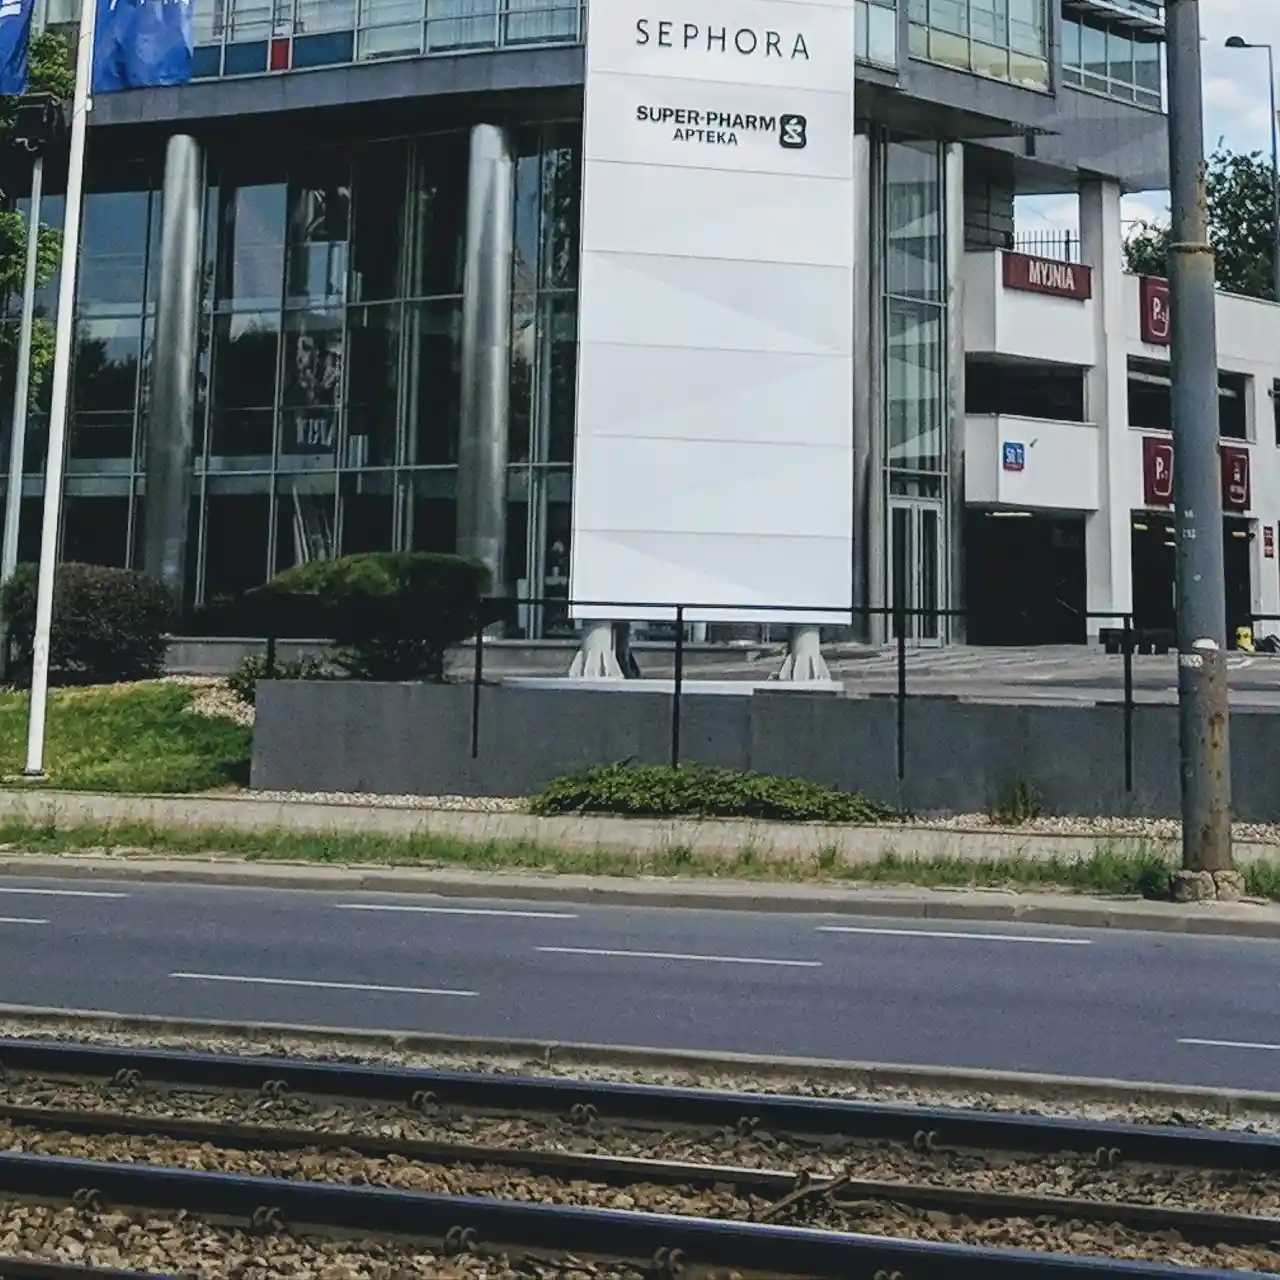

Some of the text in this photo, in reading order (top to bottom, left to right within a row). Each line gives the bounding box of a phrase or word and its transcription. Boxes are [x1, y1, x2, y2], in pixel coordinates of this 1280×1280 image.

[636, 19, 810, 60] SEPHORA
[636, 105, 776, 132] SUPER-PHARM
[673, 128, 738, 146] APTEKA
[1029, 259, 1076, 290] MYJNIA
